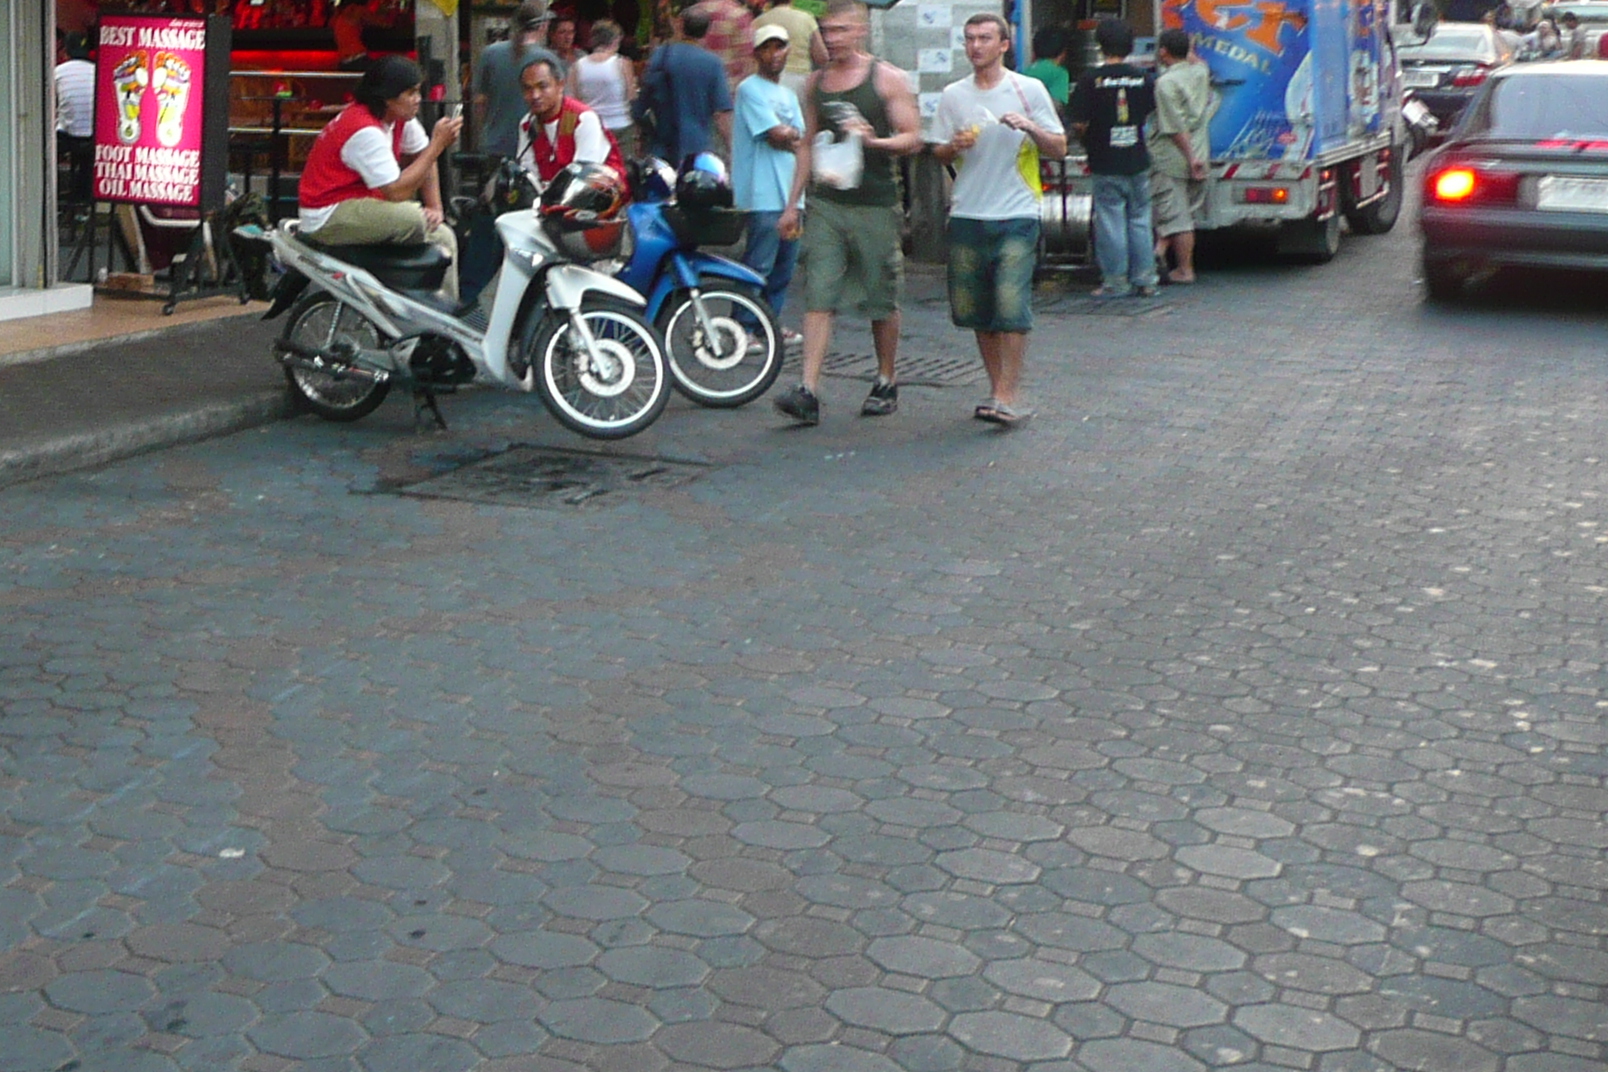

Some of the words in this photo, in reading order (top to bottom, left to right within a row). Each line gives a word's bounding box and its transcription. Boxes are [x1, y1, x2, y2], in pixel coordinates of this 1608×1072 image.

[99, 25, 136, 46] BEST
[137, 26, 206, 50] MASSAGE
[1192, 31, 1272, 76] MEDAL
[94, 144, 133, 162] FOOT
[135, 146, 200, 168] MASSAGE
[93, 160, 133, 180] THAI
[134, 163, 200, 186] MASSAGE
[98, 178, 128, 197] OIL
[128, 181, 194, 203] MASSAGE
